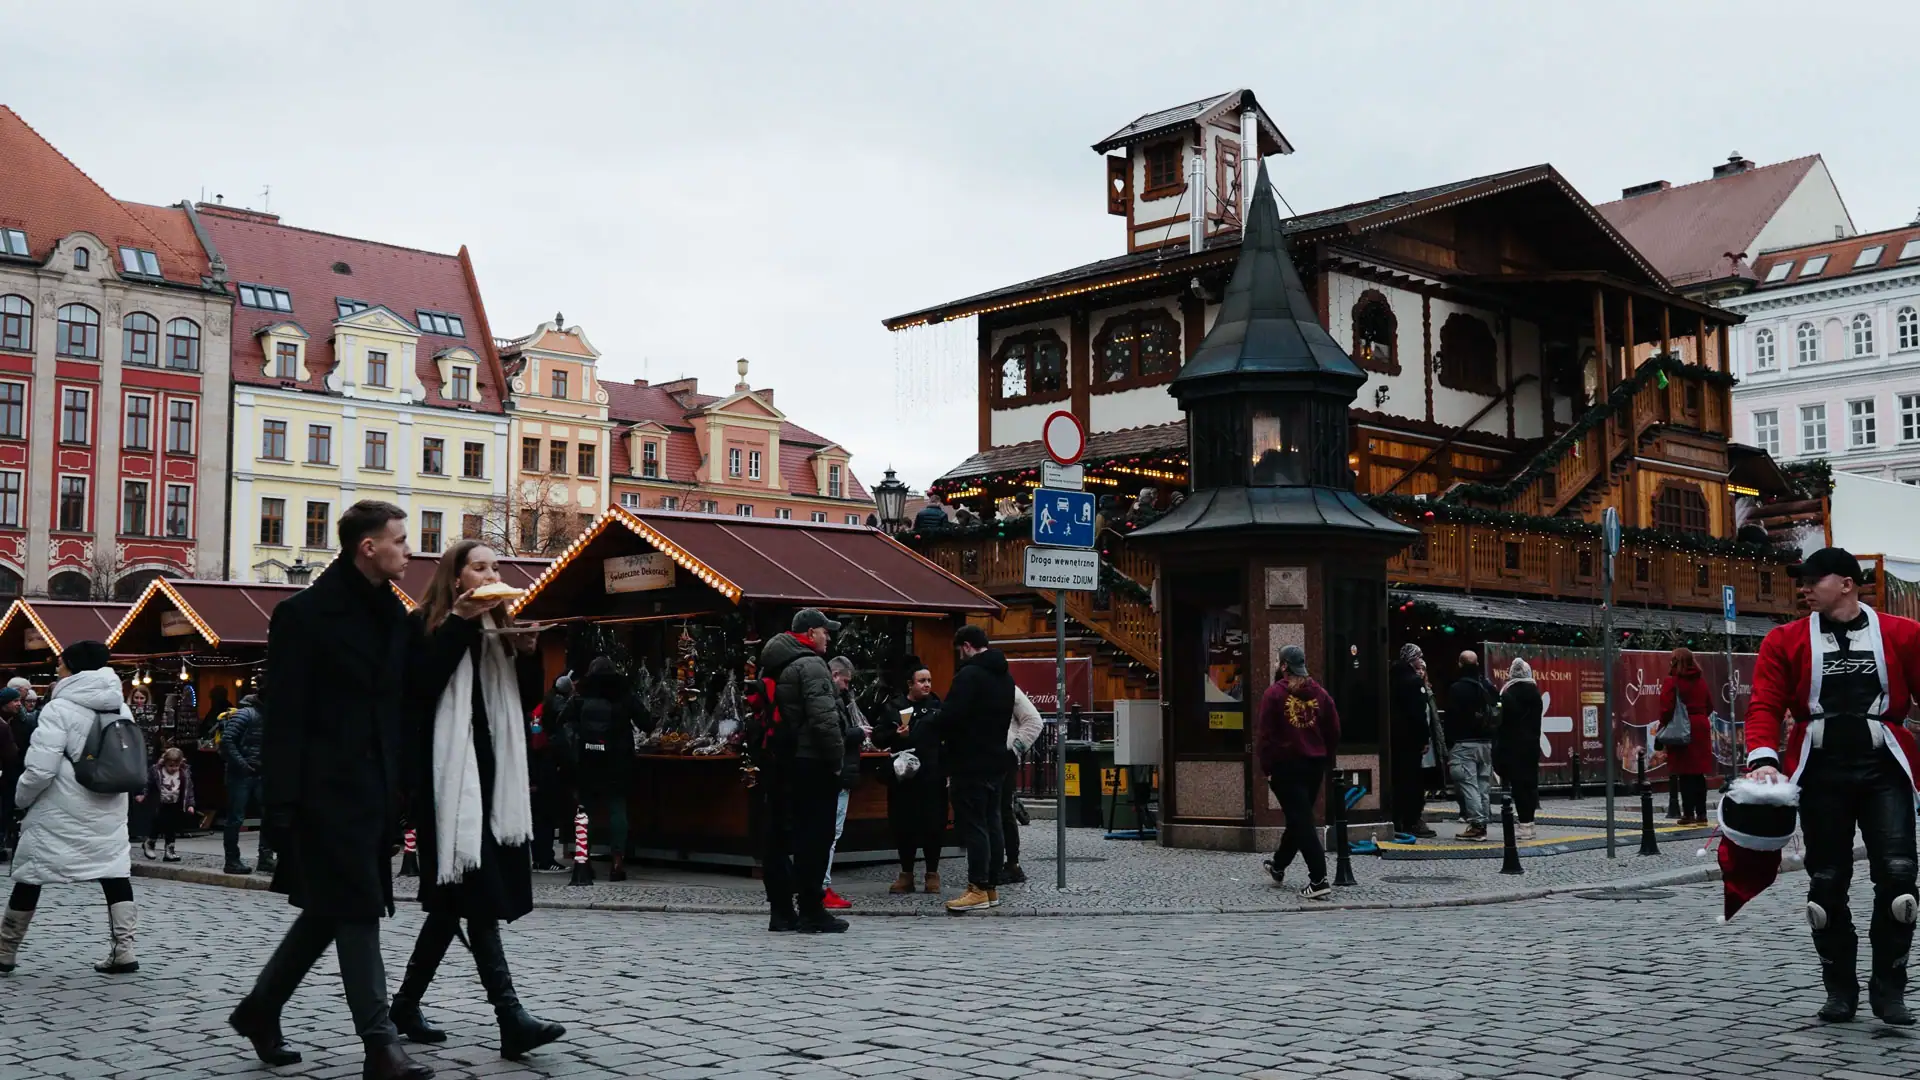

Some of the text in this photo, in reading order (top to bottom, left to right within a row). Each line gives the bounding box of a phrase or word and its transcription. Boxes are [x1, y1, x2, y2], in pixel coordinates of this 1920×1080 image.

[1030, 554, 1095, 568] Droga wewnętrzna
[641, 567, 669, 578] Dekoracje
[1726, 588, 1733, 610] P
[1493, 667, 1510, 681] WEJŚ
[1550, 670, 1573, 681] SOLNY
